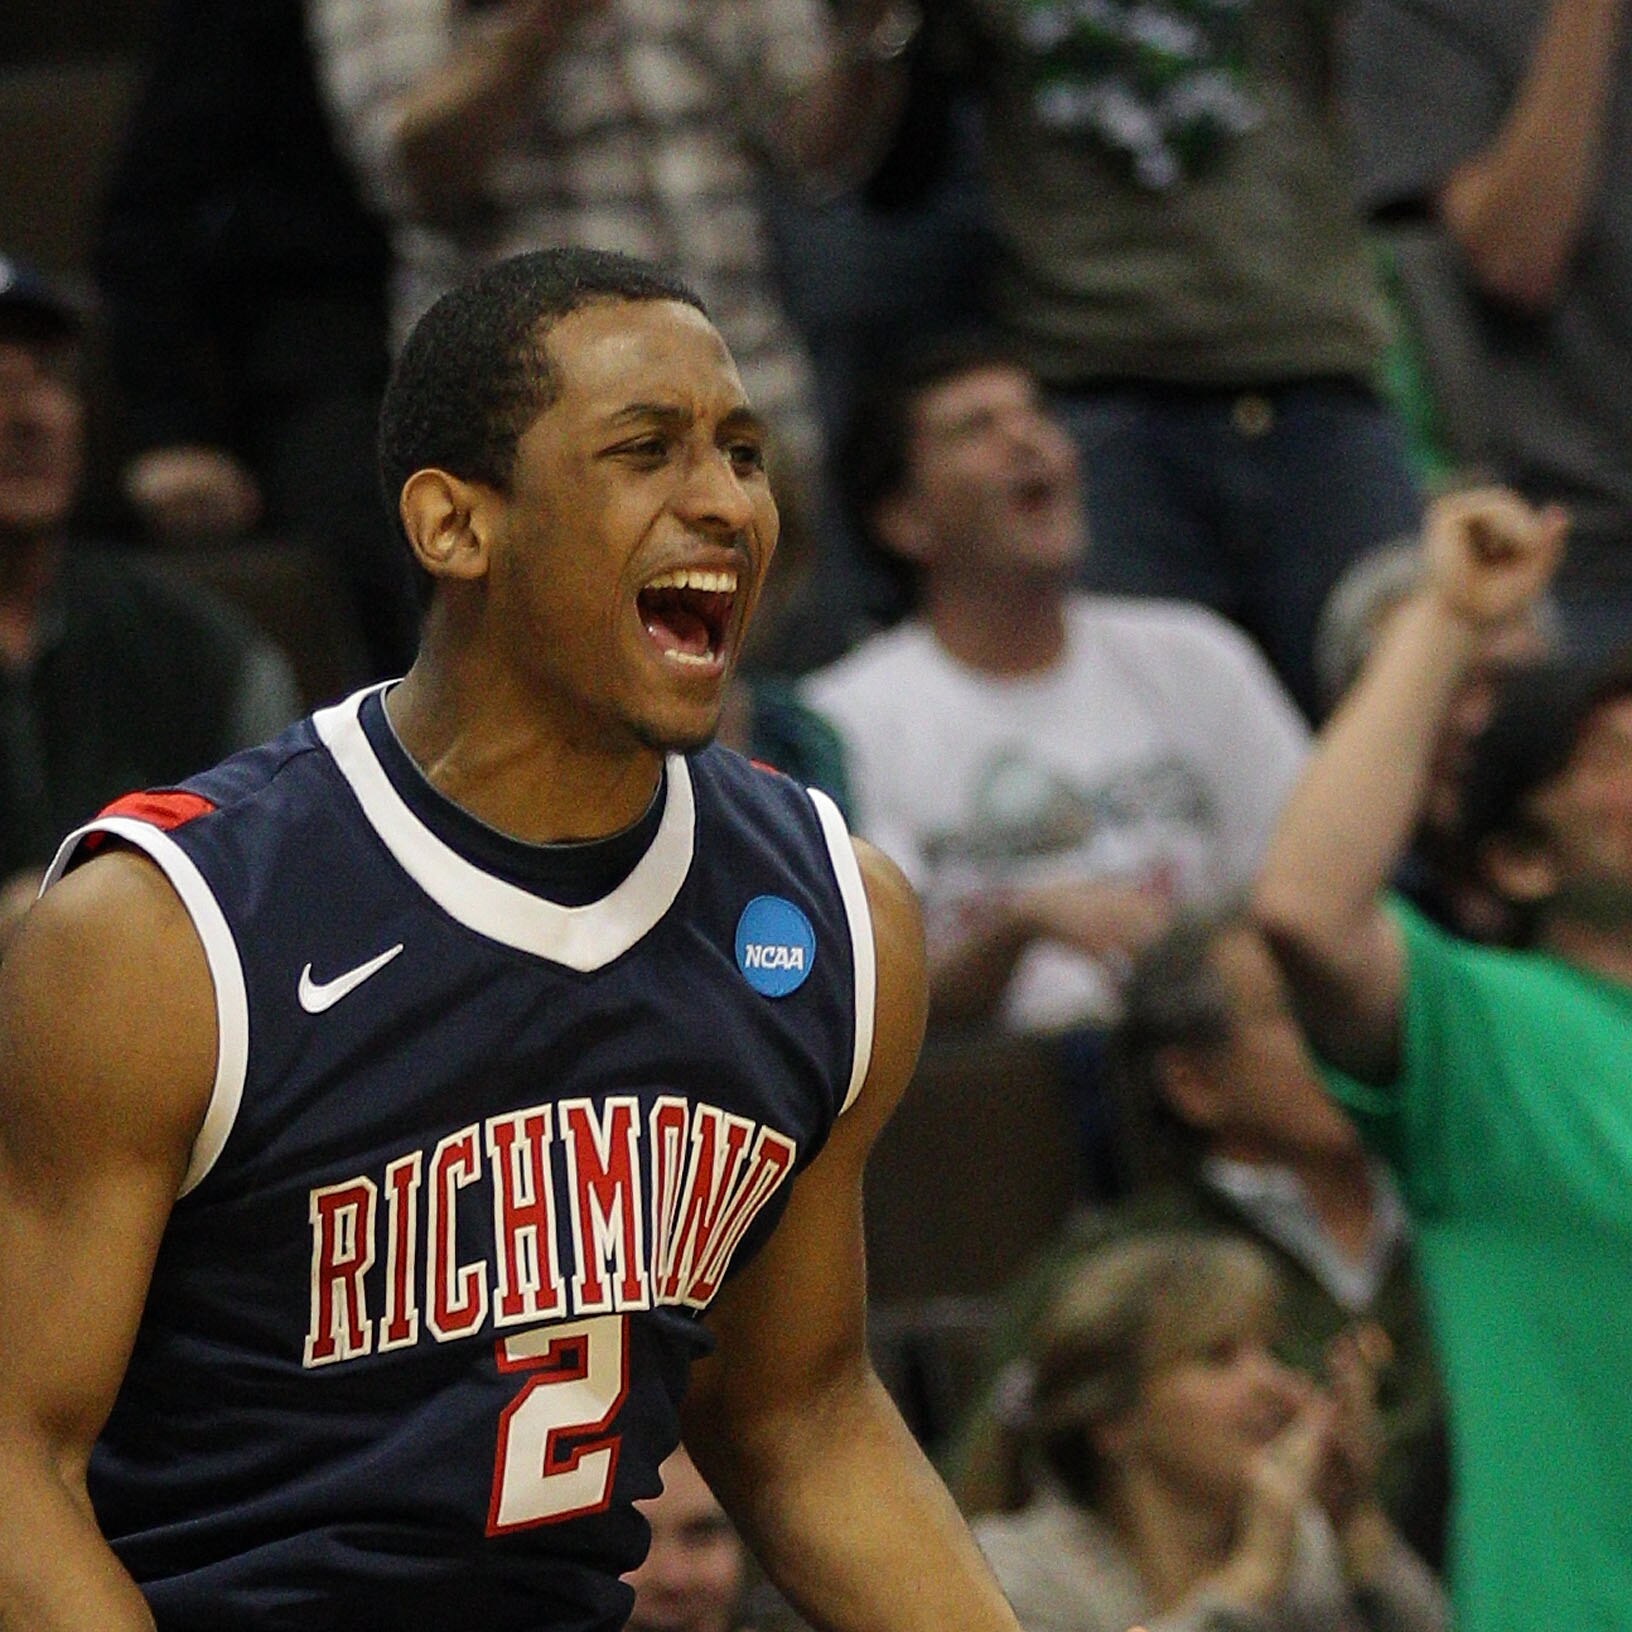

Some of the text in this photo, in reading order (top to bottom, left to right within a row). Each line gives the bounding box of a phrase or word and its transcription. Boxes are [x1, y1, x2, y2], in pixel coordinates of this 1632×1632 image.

[744, 942, 804, 972] NCAA
[302, 1095, 798, 1367] RICHMOND
[485, 1315, 631, 1538] 2
